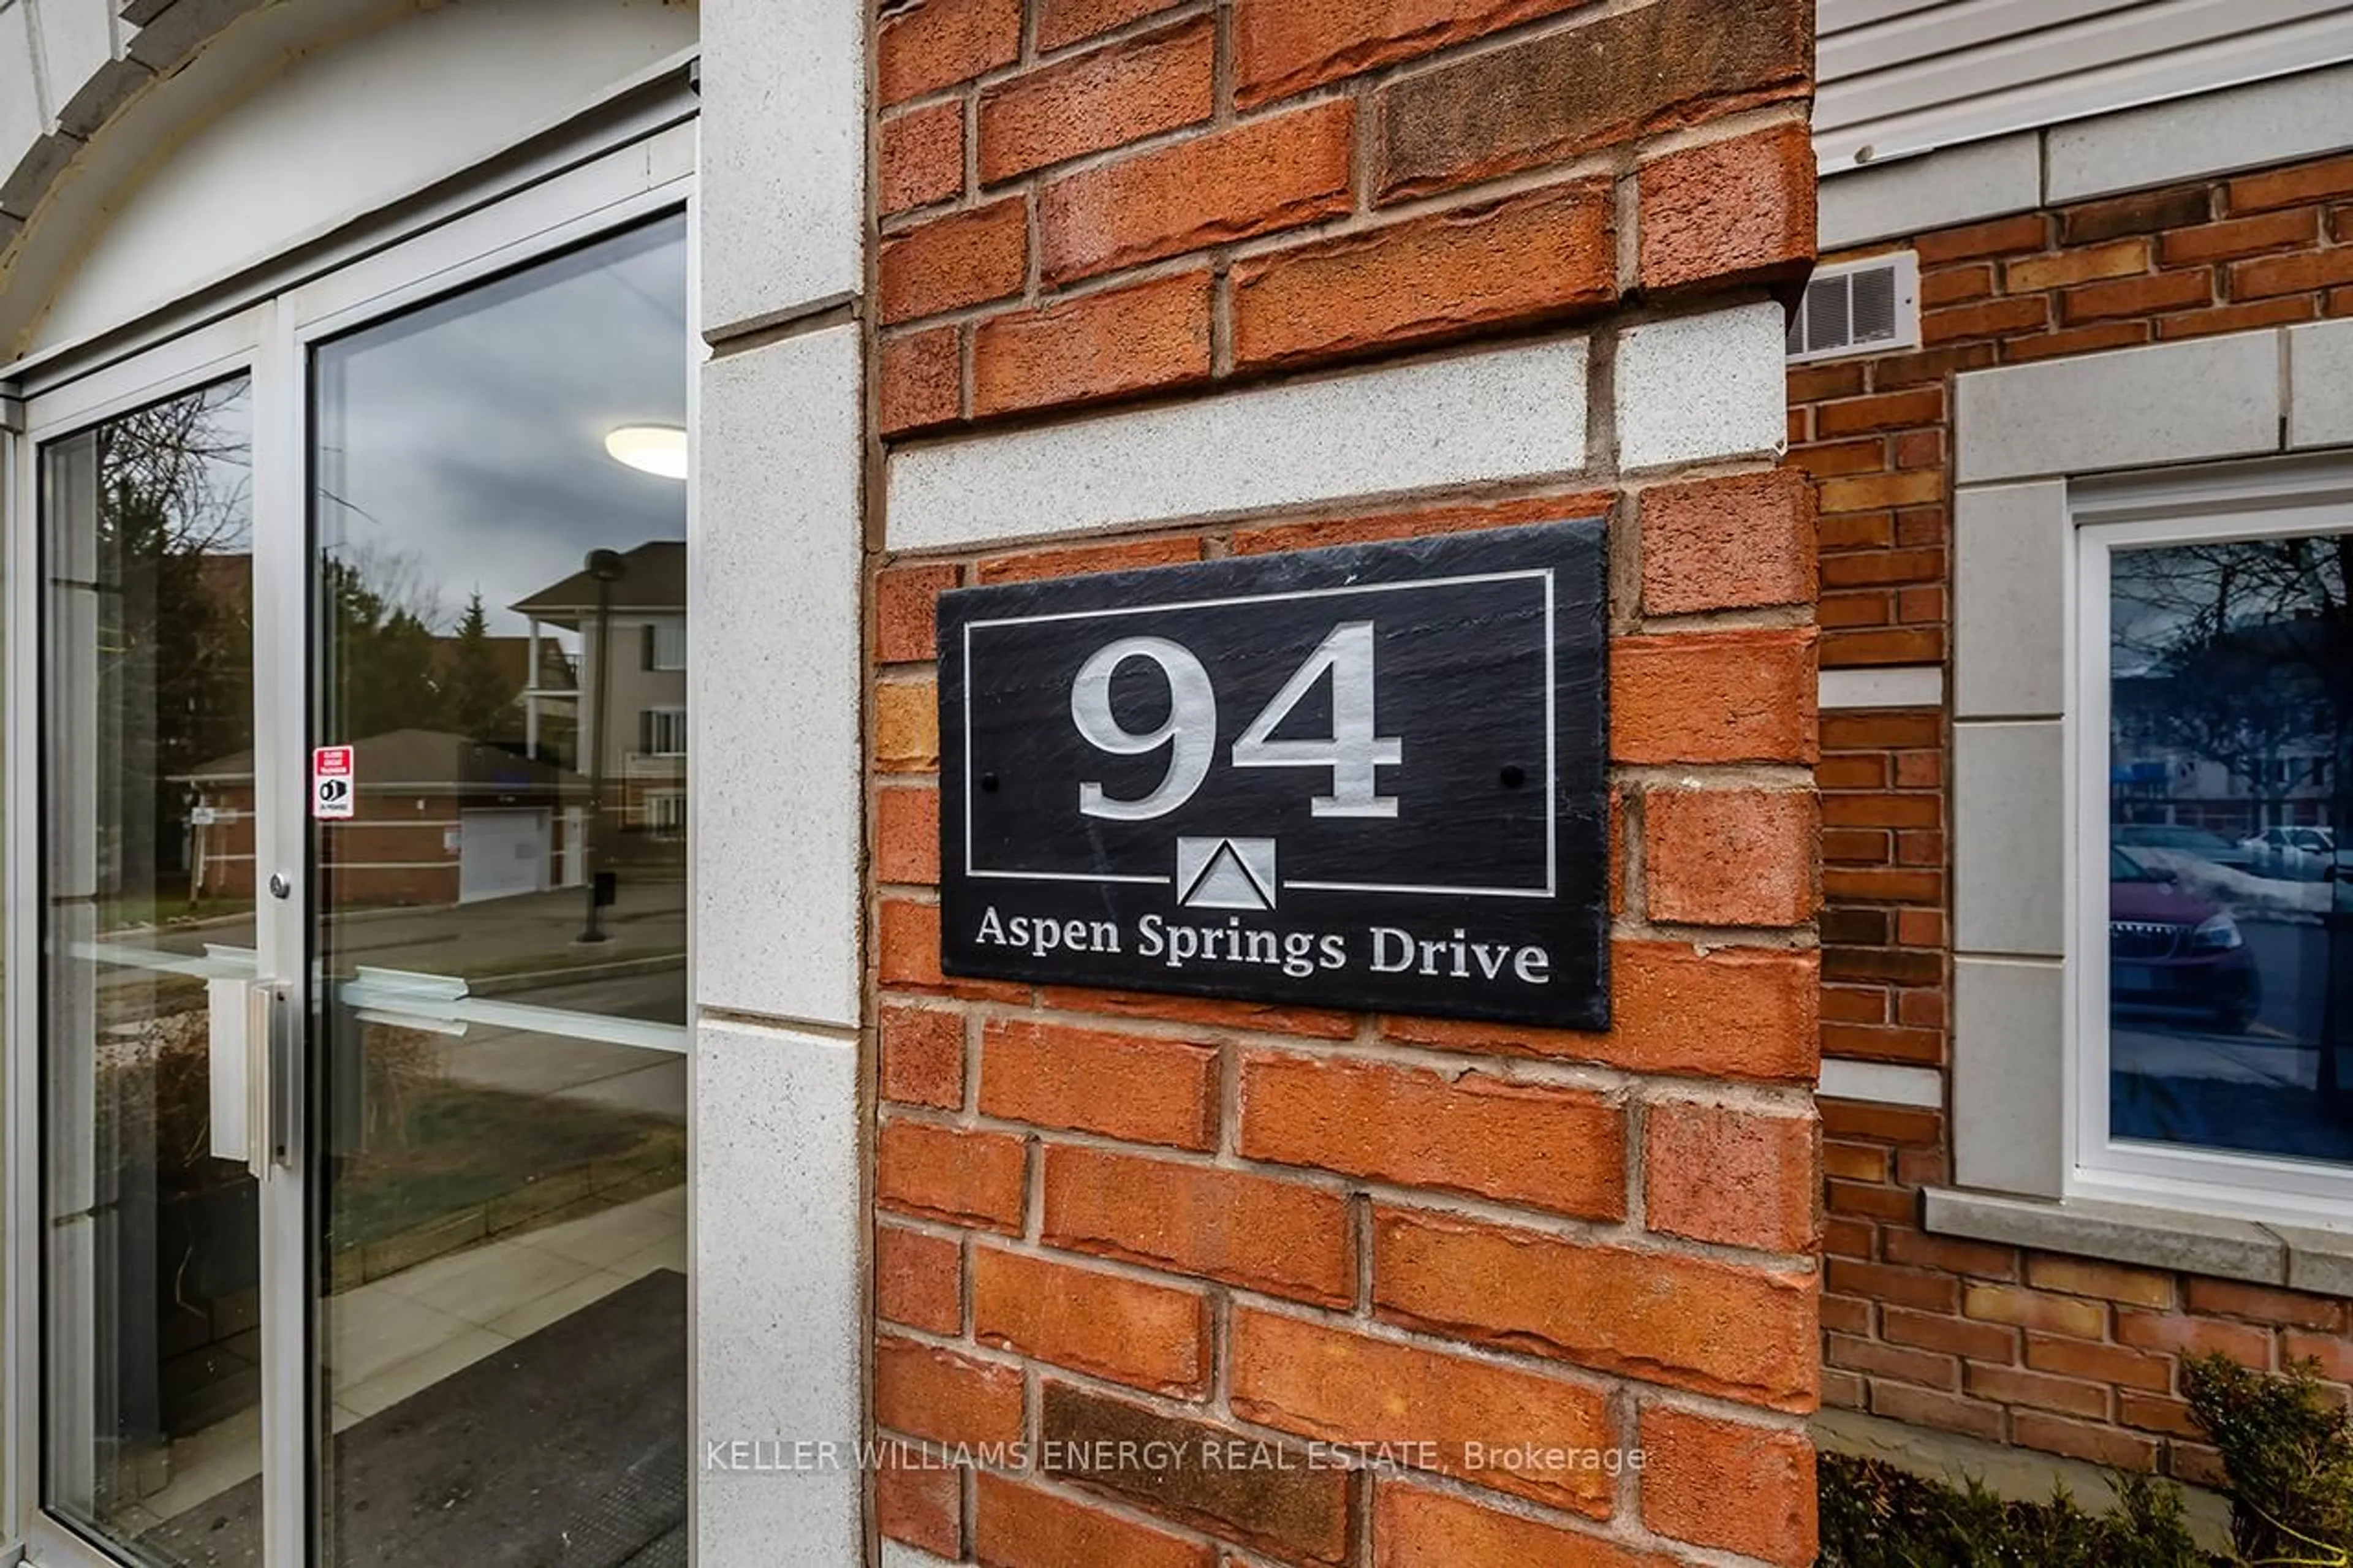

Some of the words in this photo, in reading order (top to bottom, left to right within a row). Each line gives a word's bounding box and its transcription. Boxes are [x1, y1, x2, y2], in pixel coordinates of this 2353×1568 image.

[1070, 619, 1402, 821] 94
[976, 906, 1121, 957] Aspen
[1138, 914, 1347, 977] Springs
[1369, 926, 1550, 983] Drive
